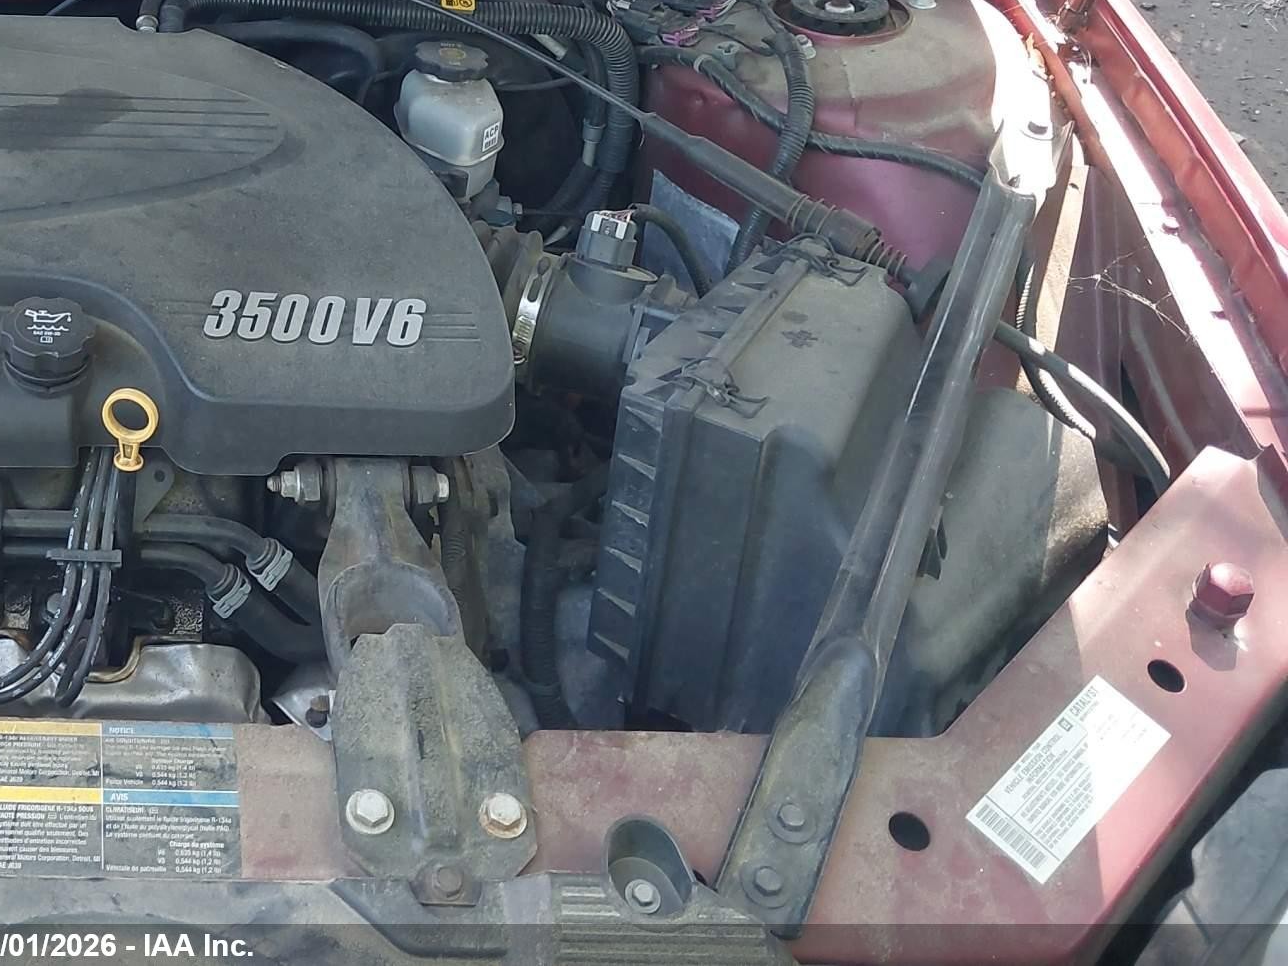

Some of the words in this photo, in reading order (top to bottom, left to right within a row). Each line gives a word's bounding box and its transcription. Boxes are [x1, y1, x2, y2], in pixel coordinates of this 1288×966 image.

[203, 290, 346, 344] 3500
[352, 297, 427, 347] V6
[1070, 686, 1098, 717] CATALYST
